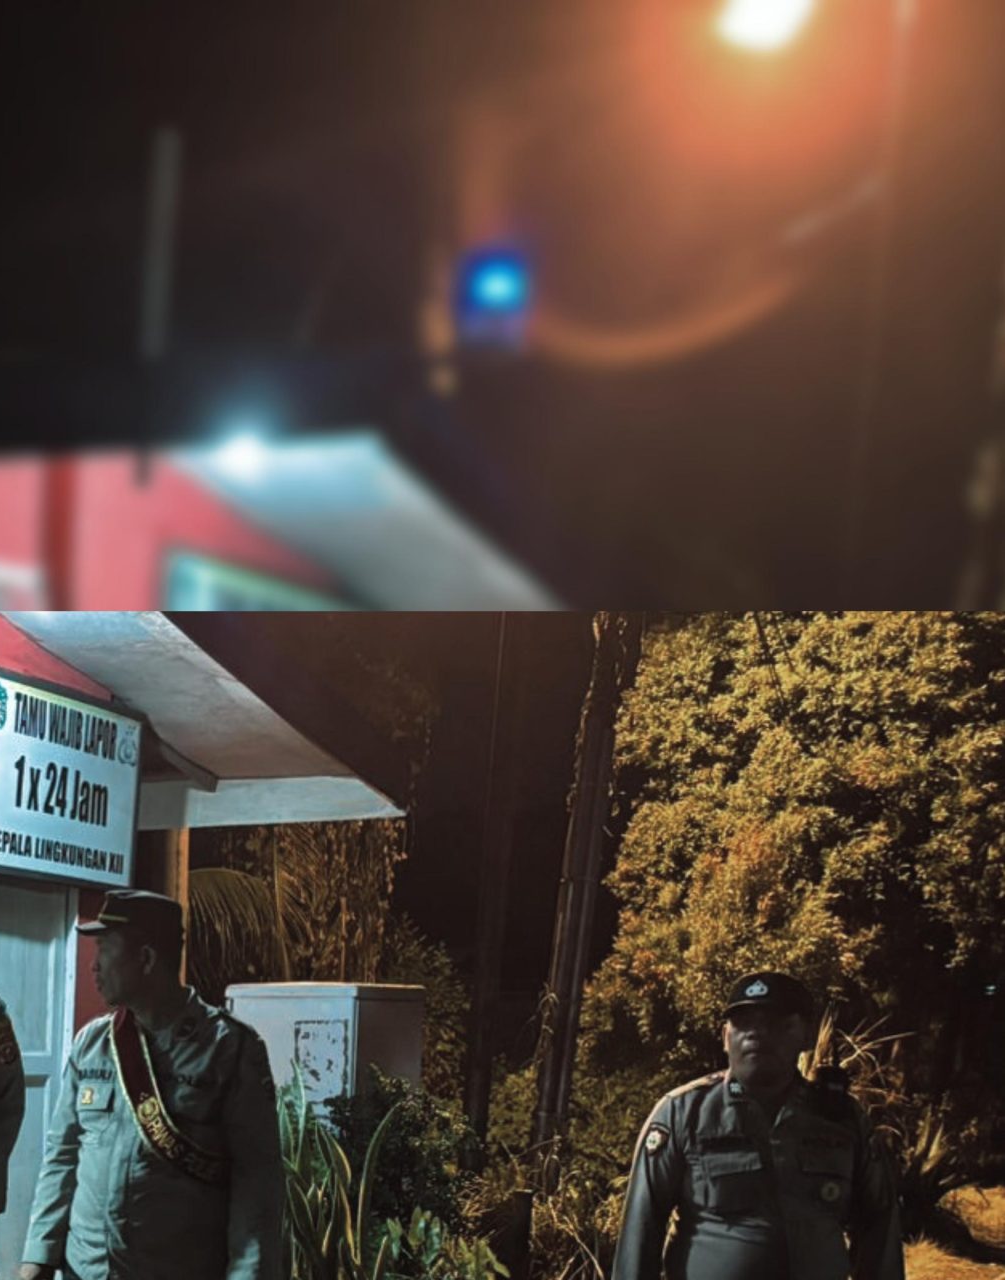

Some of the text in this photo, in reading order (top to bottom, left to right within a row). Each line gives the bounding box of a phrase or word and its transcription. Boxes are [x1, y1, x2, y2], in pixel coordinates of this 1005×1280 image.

[14, 691, 117, 761] TAMU WAJIB LAPOR
[14, 755, 109, 828] 1 x 24 Jam
[34, 837, 107, 872] LINGKUNGAN
[108, 851, 125, 875] XII
